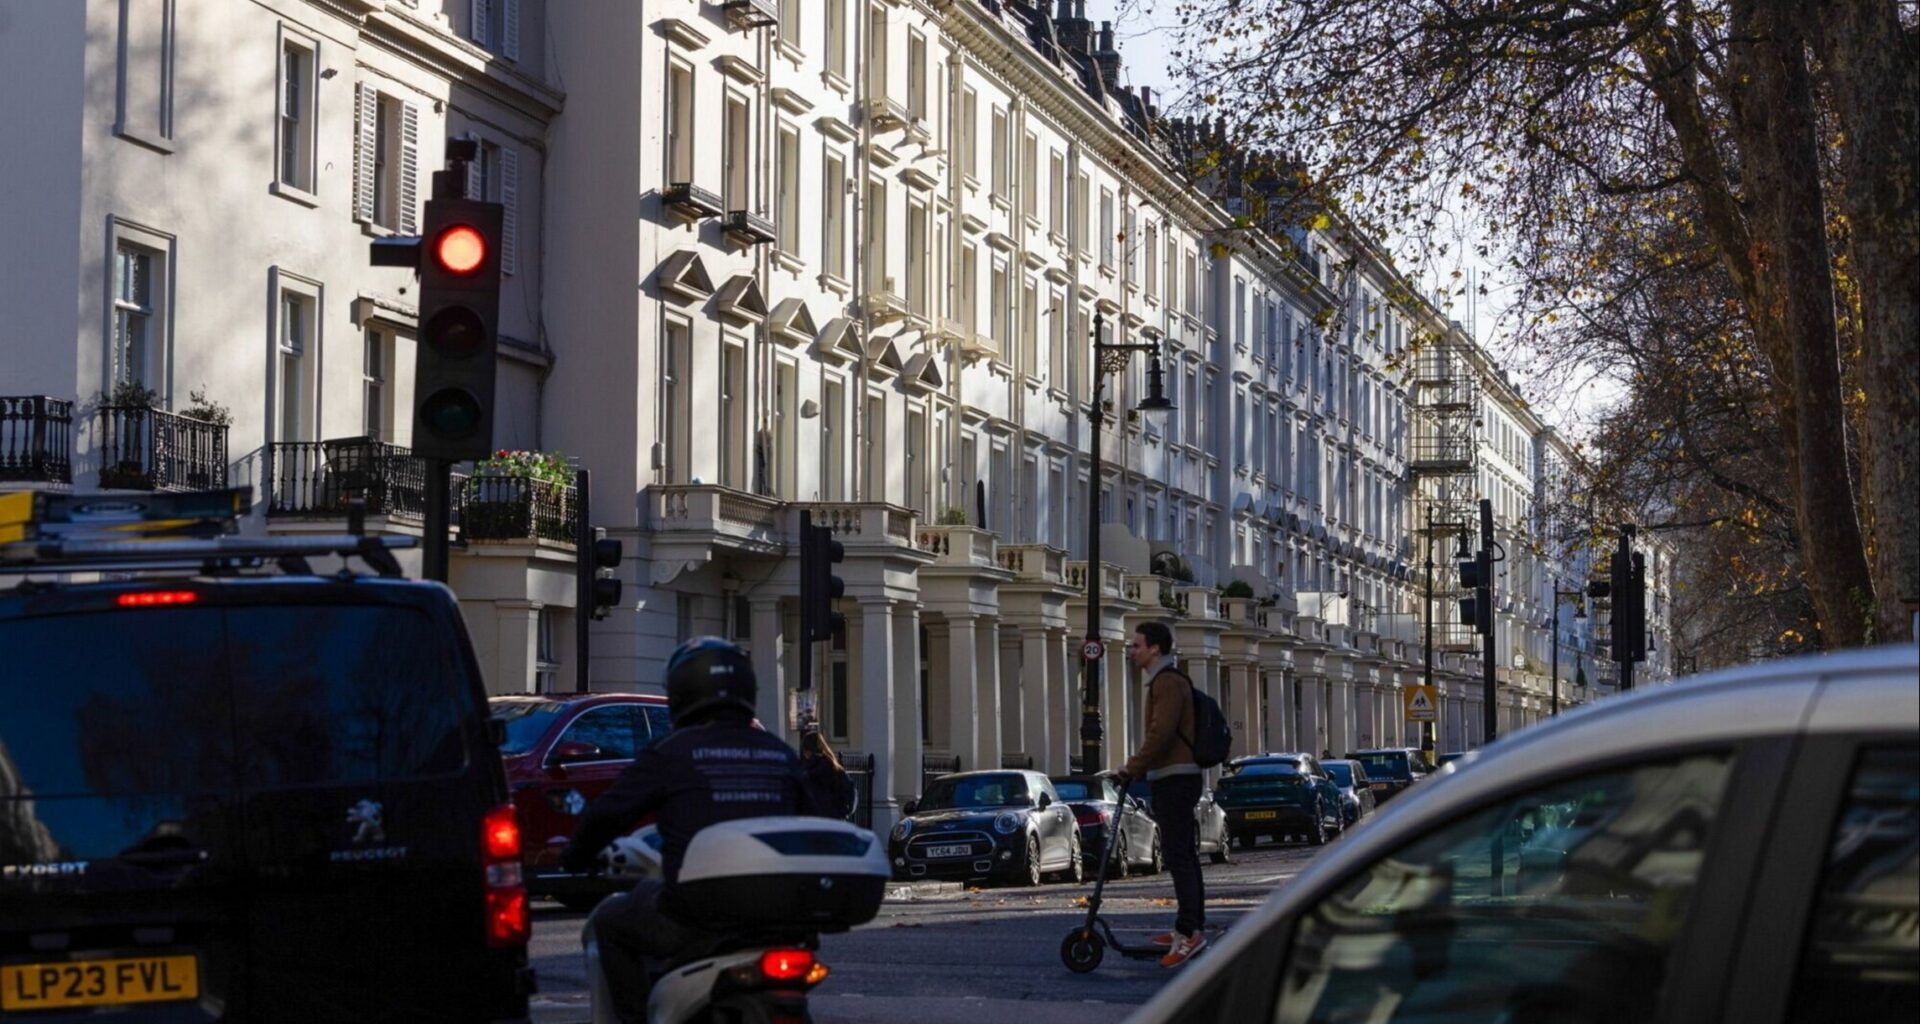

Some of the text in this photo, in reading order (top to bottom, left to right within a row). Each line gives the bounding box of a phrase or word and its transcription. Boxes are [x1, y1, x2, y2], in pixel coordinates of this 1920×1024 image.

[1086, 645, 1098, 655] 20
[692, 748, 787, 761] LETHBRIDGE LONDON
[330, 847, 408, 861] PEUGEOT
[3, 861, 89, 877] EXPERT
[16, 961, 182, 1000] LP23 FVL
